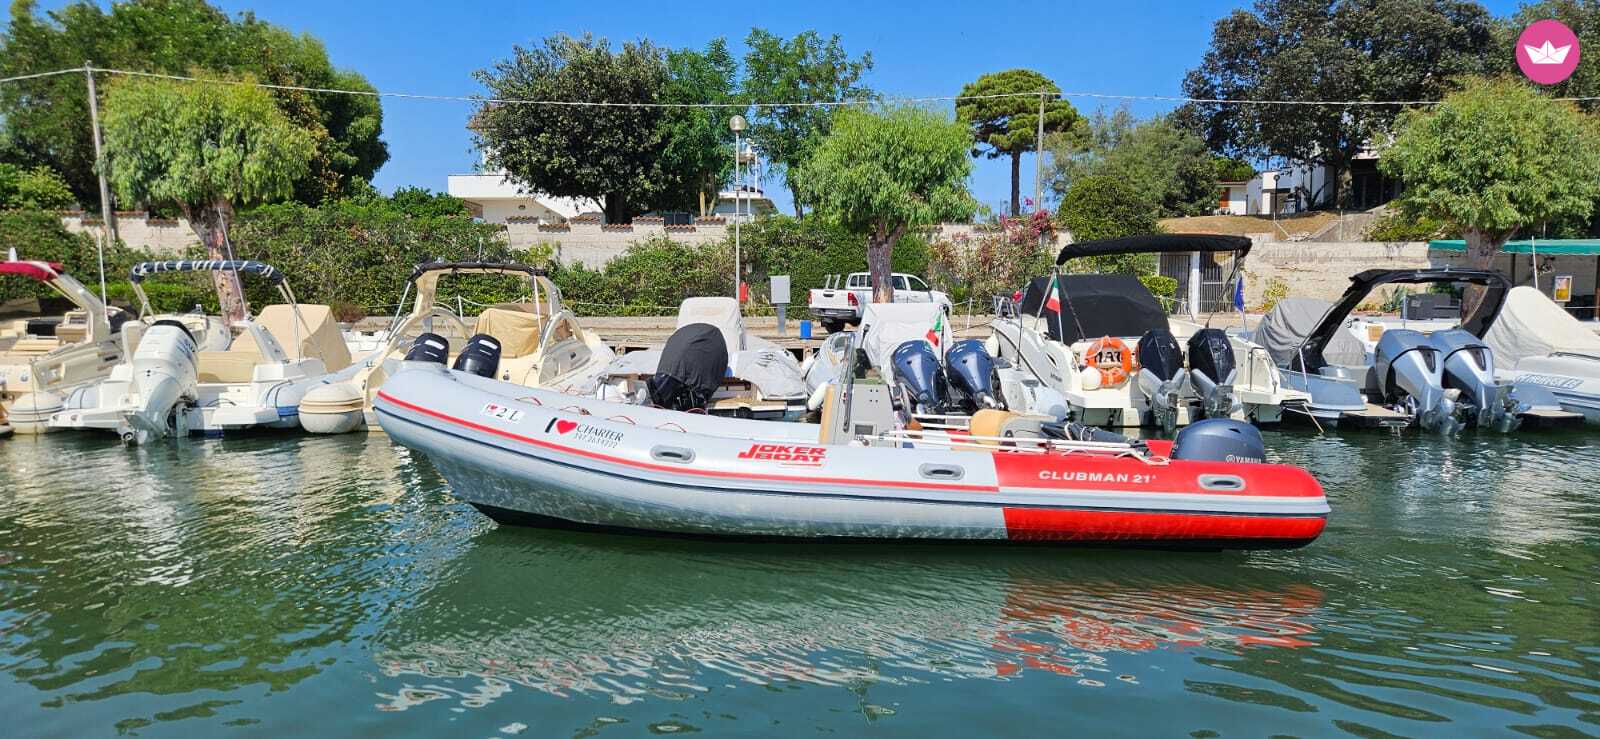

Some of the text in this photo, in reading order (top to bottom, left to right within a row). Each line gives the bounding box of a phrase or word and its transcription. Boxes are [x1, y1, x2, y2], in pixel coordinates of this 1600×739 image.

[544, 416, 624, 442] I CHARTER
[737, 443, 827, 459] JOKER
[753, 452, 825, 462] BOAT
[1039, 470, 1129, 483] CLUBMAN
